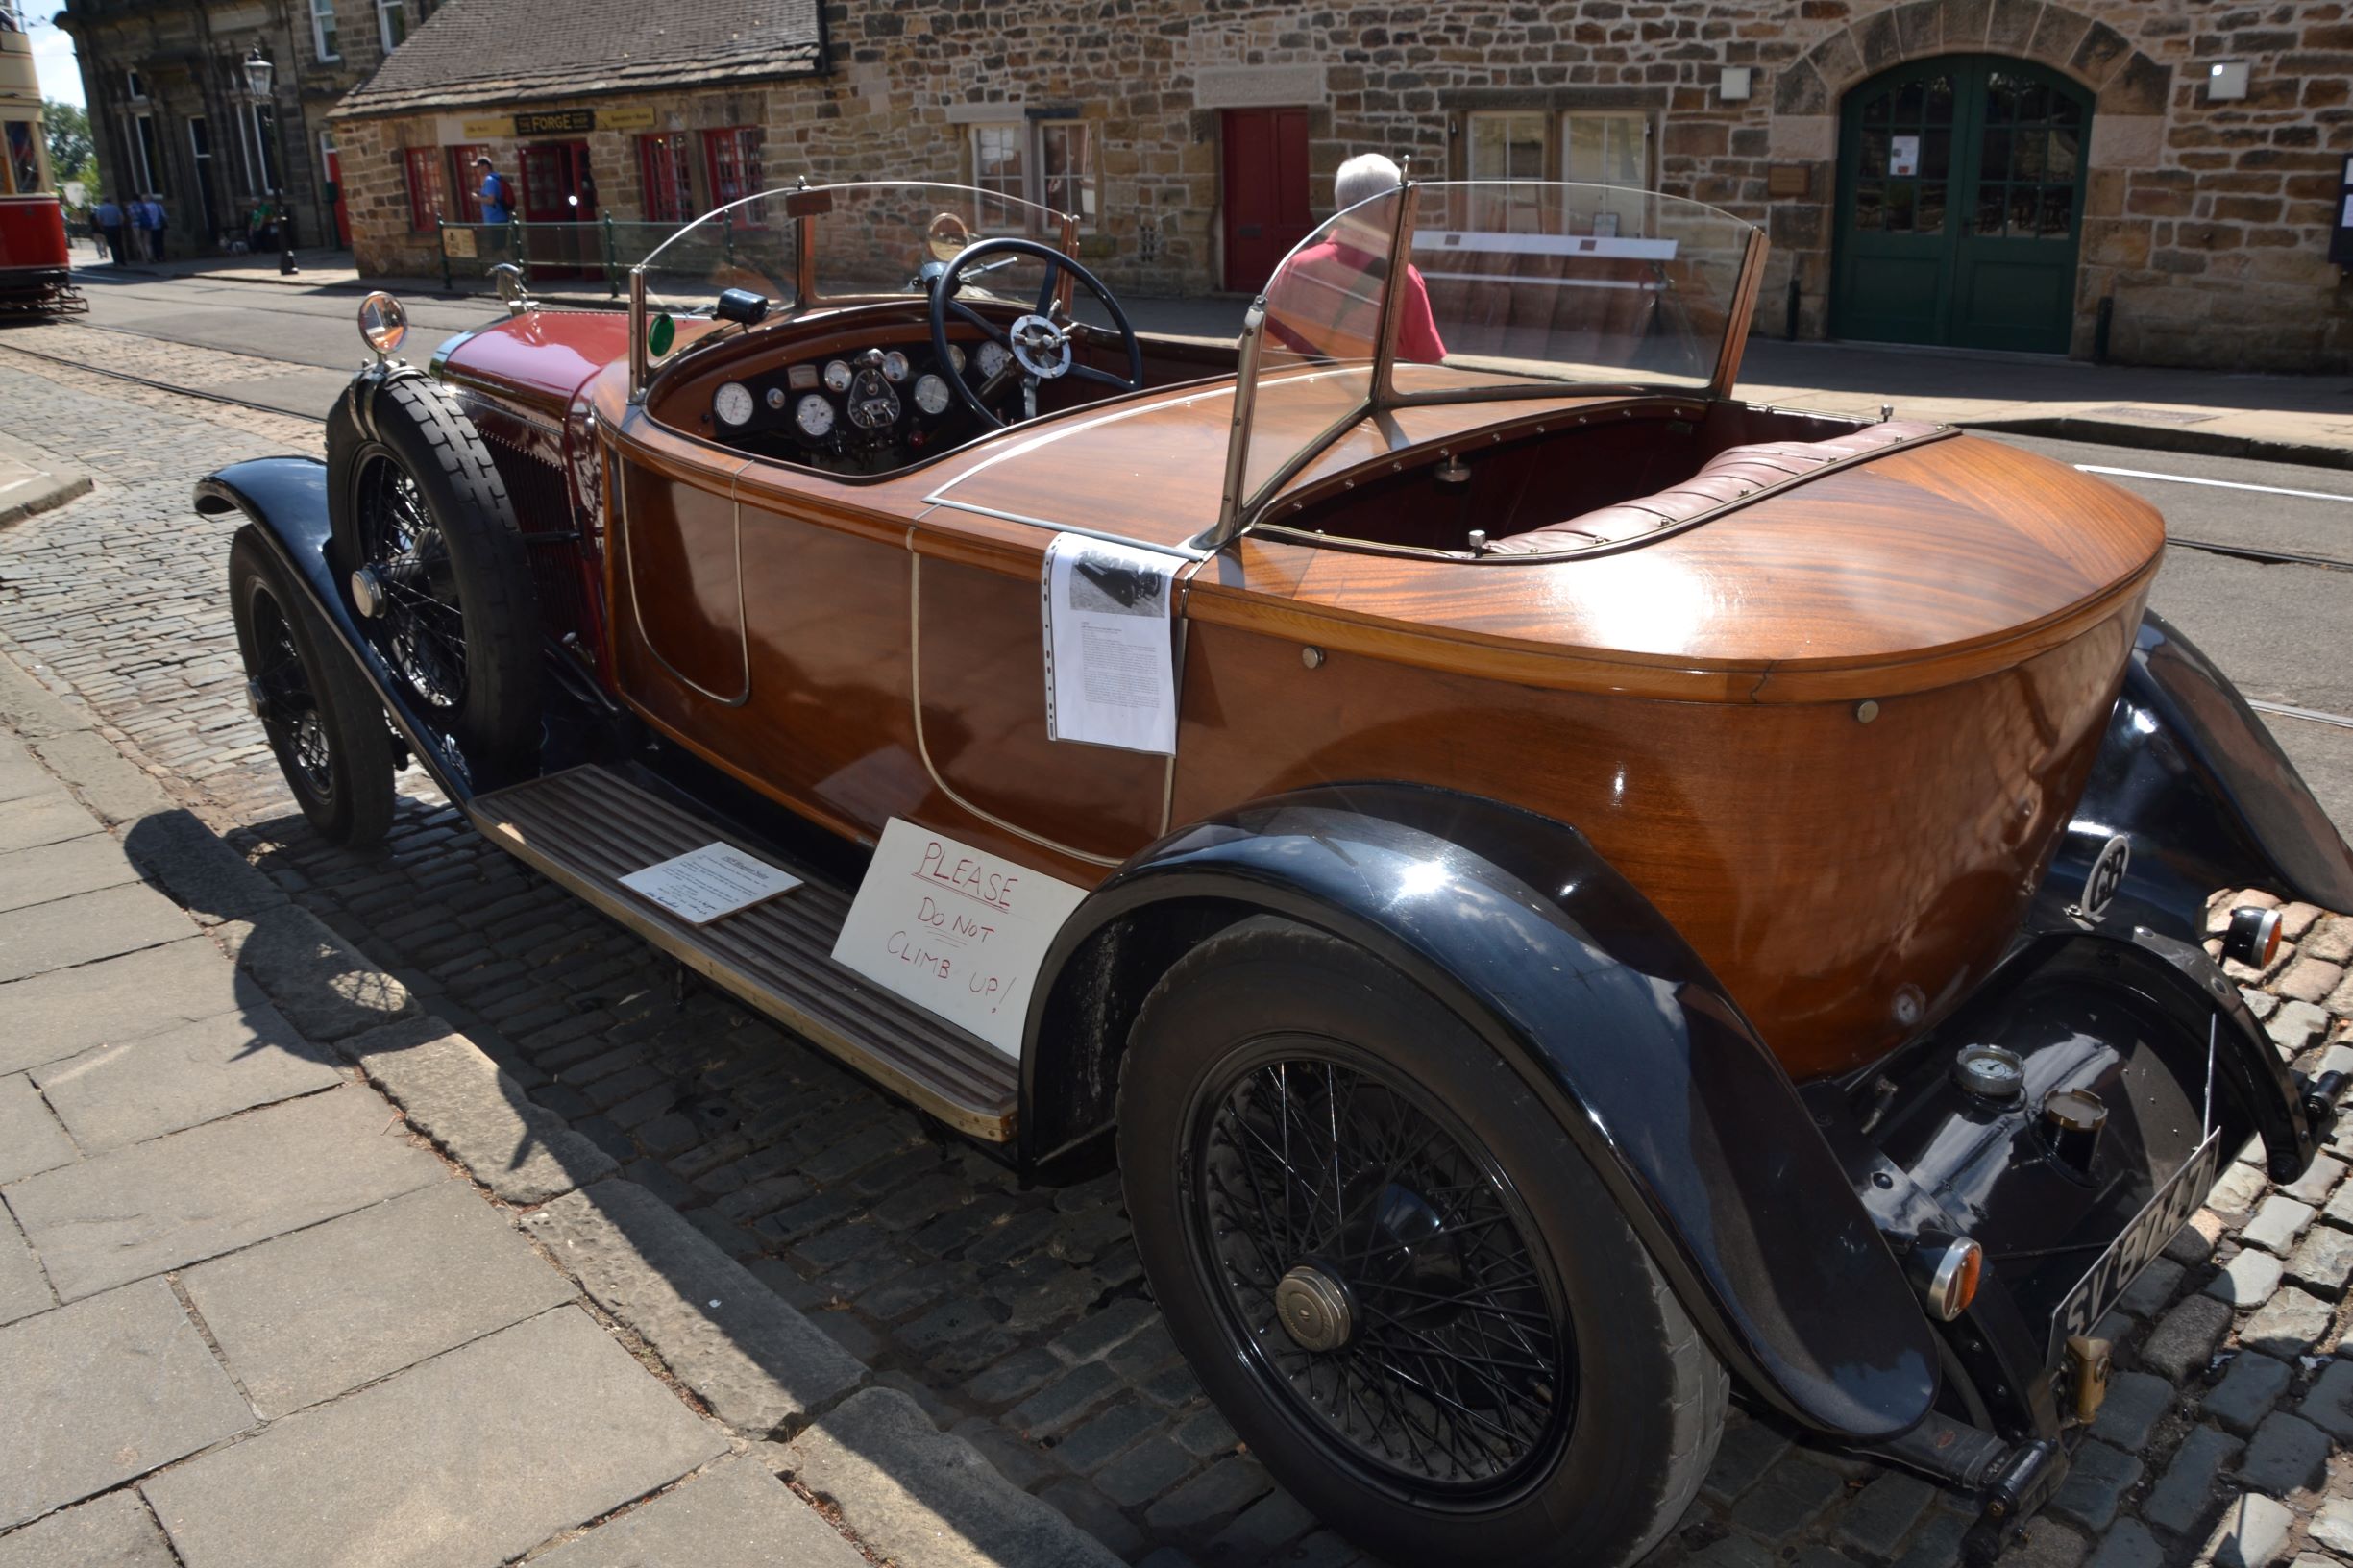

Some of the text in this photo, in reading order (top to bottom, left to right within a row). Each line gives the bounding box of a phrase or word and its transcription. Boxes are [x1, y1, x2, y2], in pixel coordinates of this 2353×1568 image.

[531, 114, 572, 133] FORGE
[918, 842, 1018, 907] PLEASE
[2089, 845, 2126, 912] GB
[887, 930, 951, 979] CLIMB
